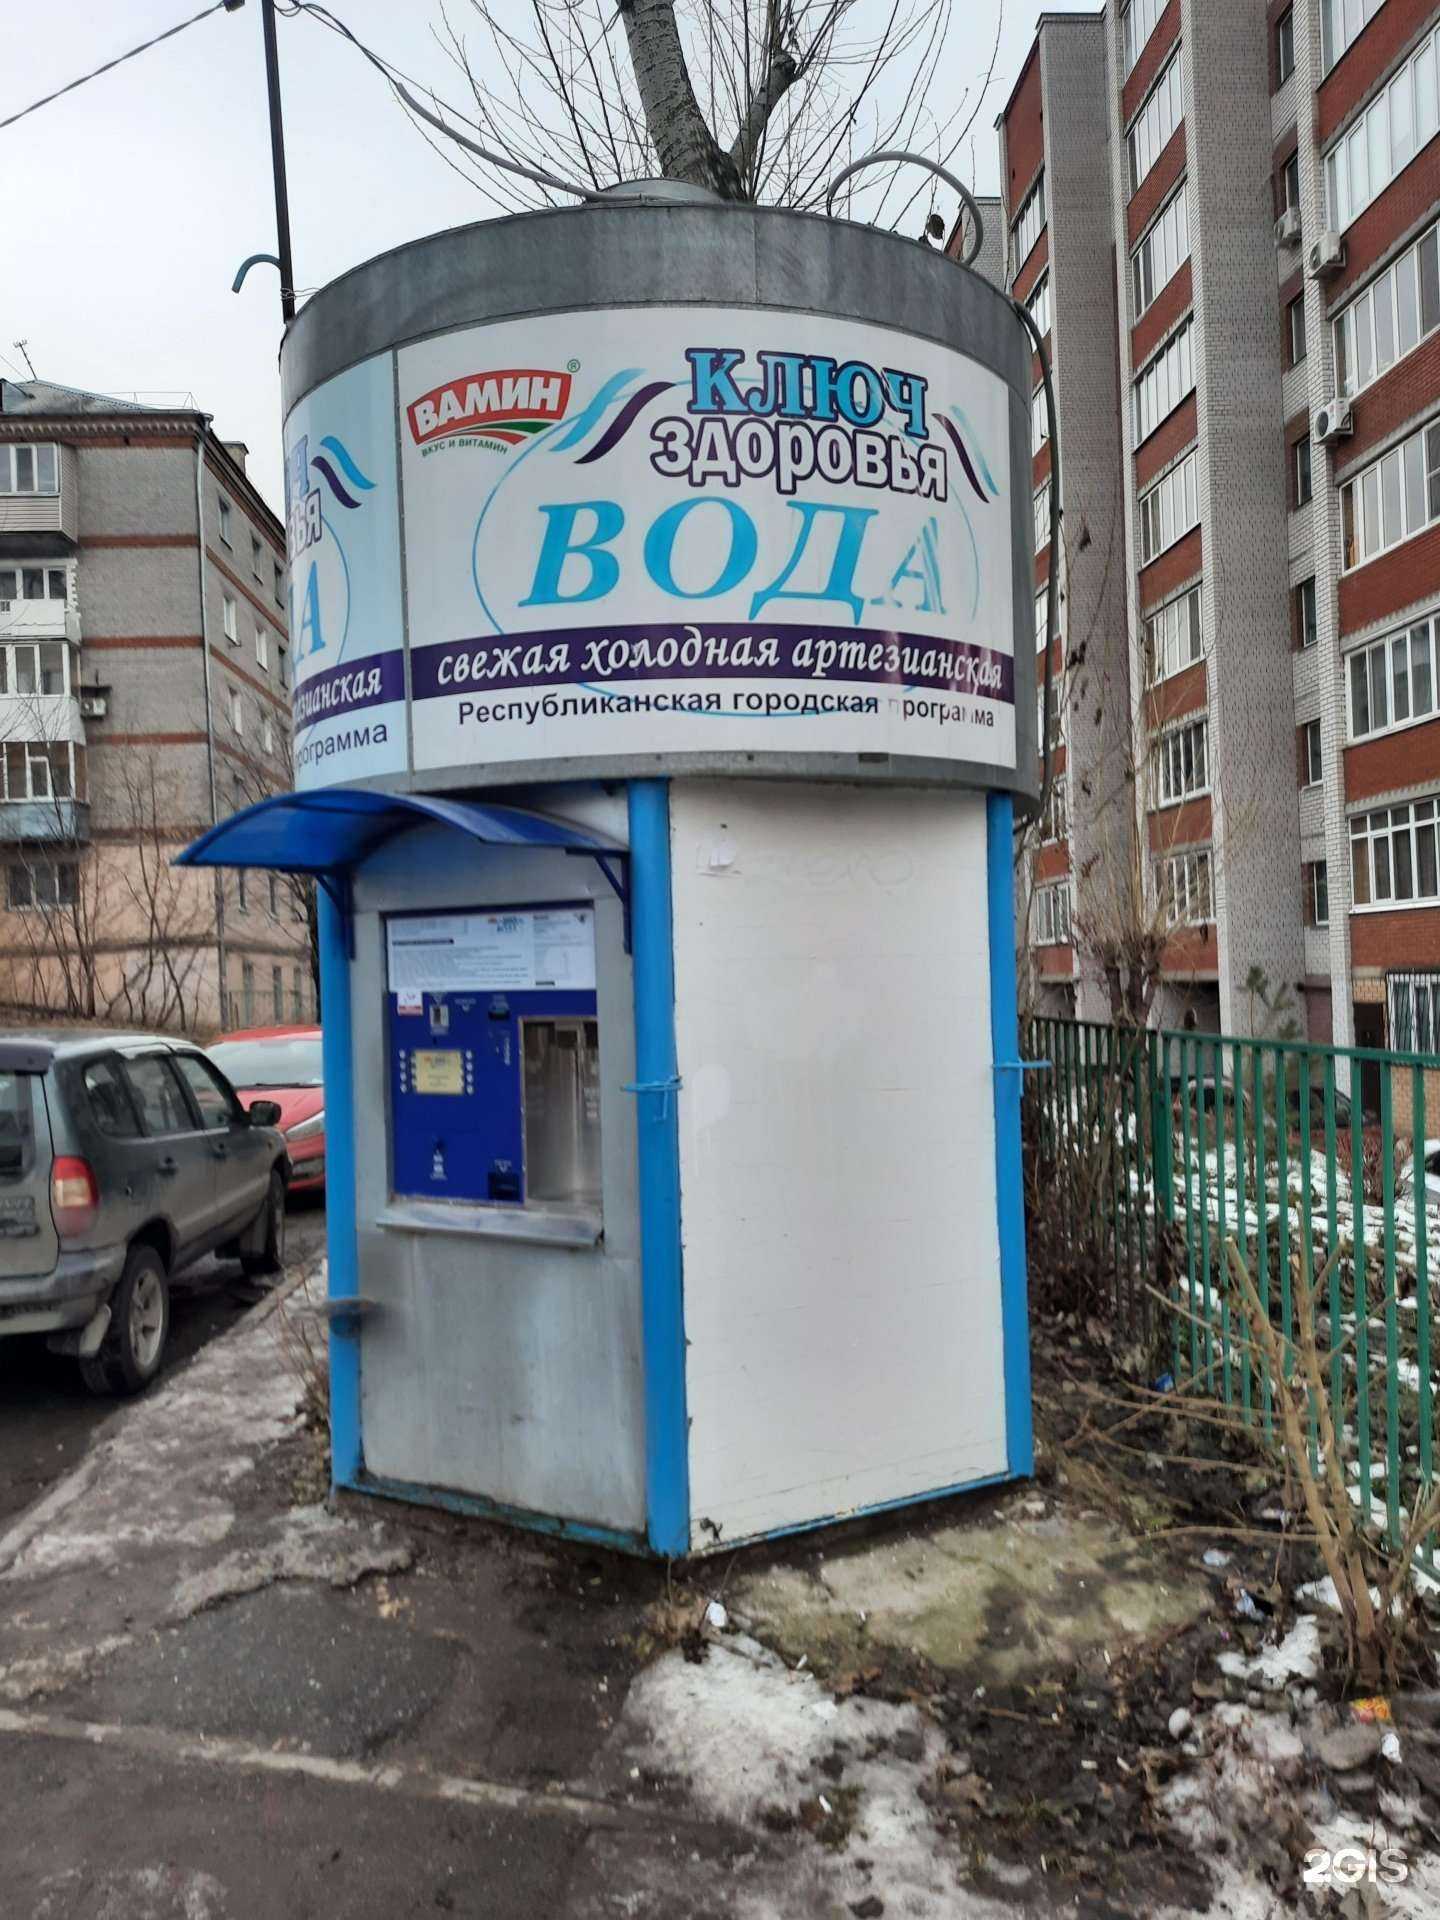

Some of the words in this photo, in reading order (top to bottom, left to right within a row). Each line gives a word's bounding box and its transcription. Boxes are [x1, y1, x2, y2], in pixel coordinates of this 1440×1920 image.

[413, 376, 562, 437] ВАМИН
[686, 348, 929, 440] КЛЮЧ
[421, 439, 446, 457] ВКУС
[449, 438, 457, 448] И
[458, 438, 508, 455] ВИТАМИН
[518, 496, 946, 625] ВОДА
[437, 642, 571, 686] свежая
[580, 625, 780, 676] холодная
[791, 636, 1003, 695] артезианская
[458, 692, 722, 725] Республиканская
[733, 691, 879, 716] городская
